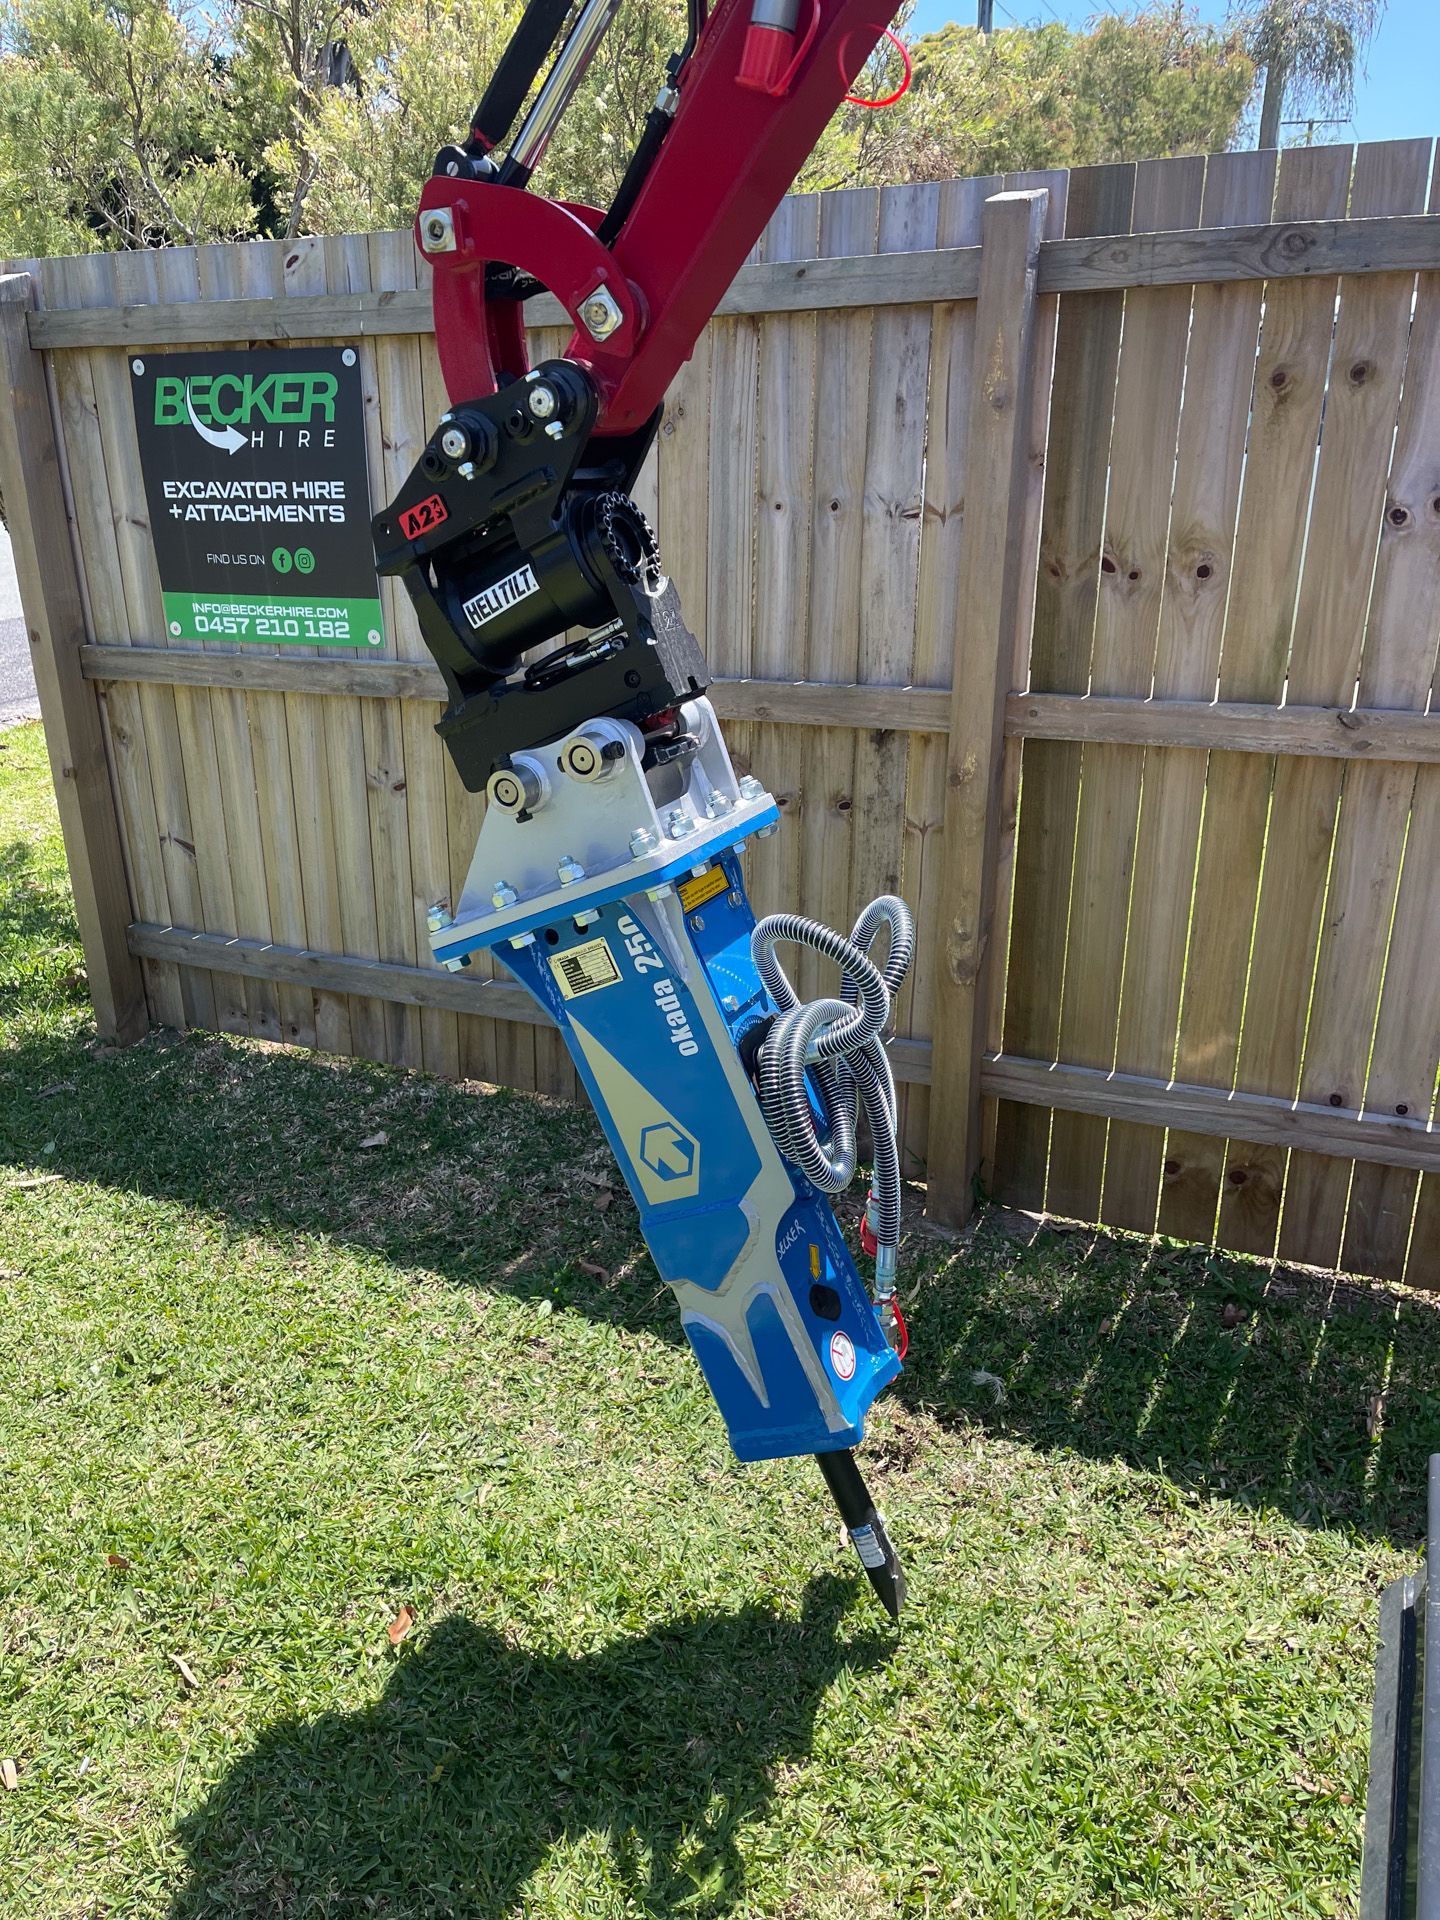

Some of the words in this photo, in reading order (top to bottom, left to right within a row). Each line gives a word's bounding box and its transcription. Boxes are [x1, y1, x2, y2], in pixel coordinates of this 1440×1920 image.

[155, 373, 338, 425] BECKER
[251, 430, 336, 448] HIRE
[162, 481, 288, 500] EXCAVATOR
[292, 481, 346, 500] HIRE
[168, 503, 346, 523] +ATTACHMENTS
[206, 553, 230, 565] FIND
[232, 554, 247, 565] US
[249, 554, 265, 566] ON
[192, 602, 348, 619] INFO@BECKERHIRE.COM
[194, 615, 250, 634] 0457
[255, 618, 300, 637] 210
[304, 620, 351, 639] 182
[617, 915, 665, 974] 250
